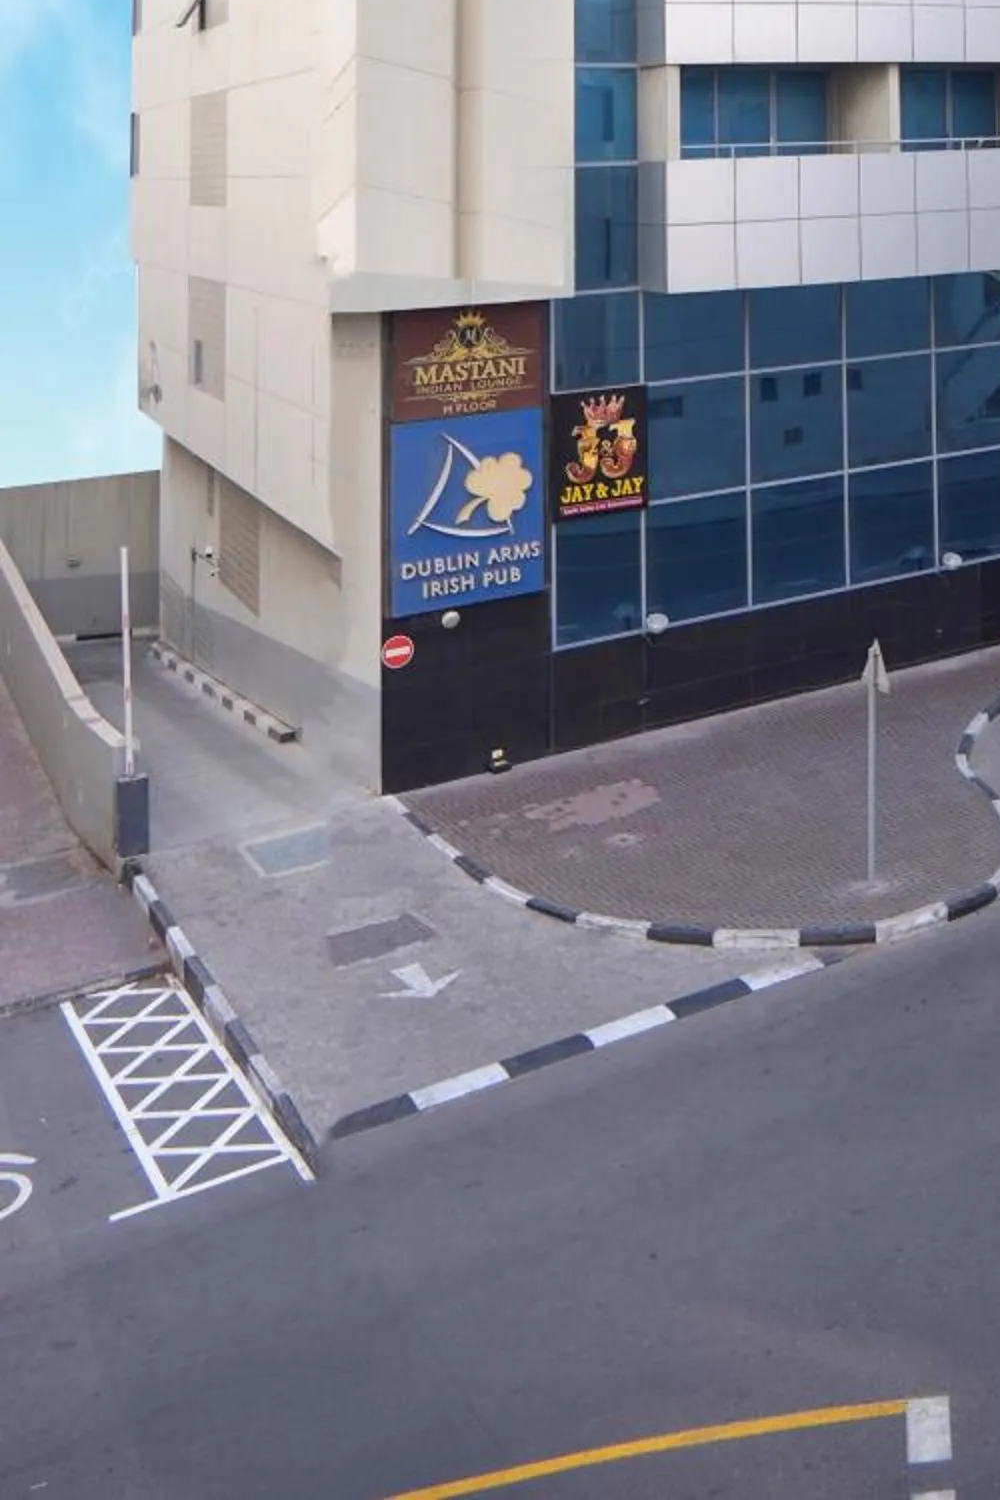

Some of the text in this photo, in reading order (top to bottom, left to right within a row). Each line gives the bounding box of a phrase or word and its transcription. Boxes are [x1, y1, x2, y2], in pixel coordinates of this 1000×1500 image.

[414, 357, 527, 385] MASTANI
[561, 476, 643, 504] JAY & JAY
[401, 541, 541, 580] DUBLIN ARMS
[422, 566, 522, 599] IRISH PUB
